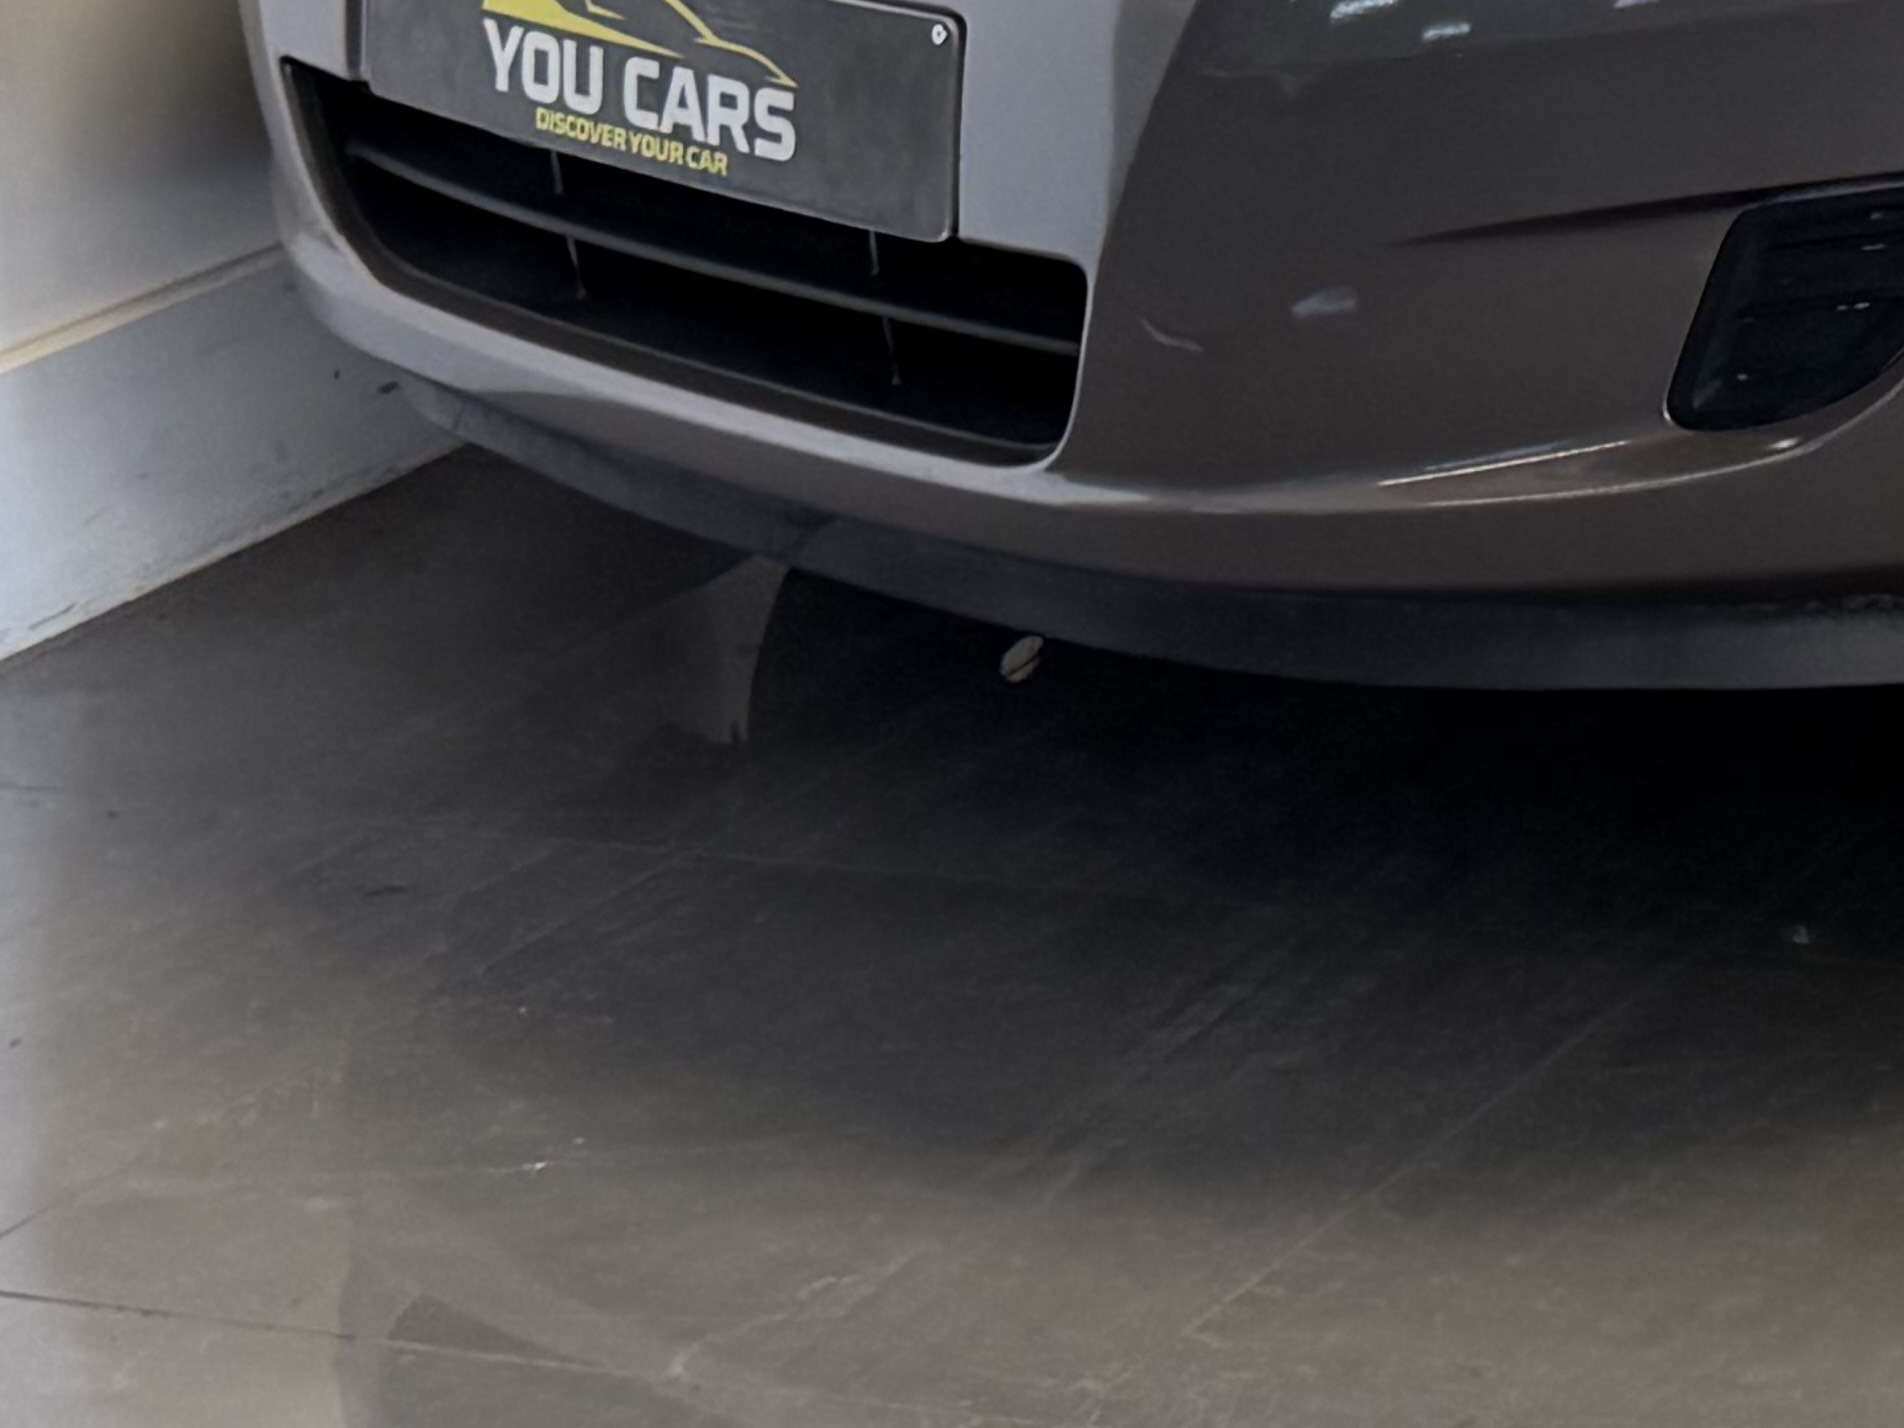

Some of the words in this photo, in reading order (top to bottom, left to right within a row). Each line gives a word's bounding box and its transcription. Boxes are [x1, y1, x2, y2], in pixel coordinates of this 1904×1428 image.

[483, 18, 603, 115] YOU
[623, 56, 796, 162] CARS
[536, 107, 627, 150] DISCOVER
[629, 132, 684, 166] YOUR
[686, 146, 729, 176] CAR
